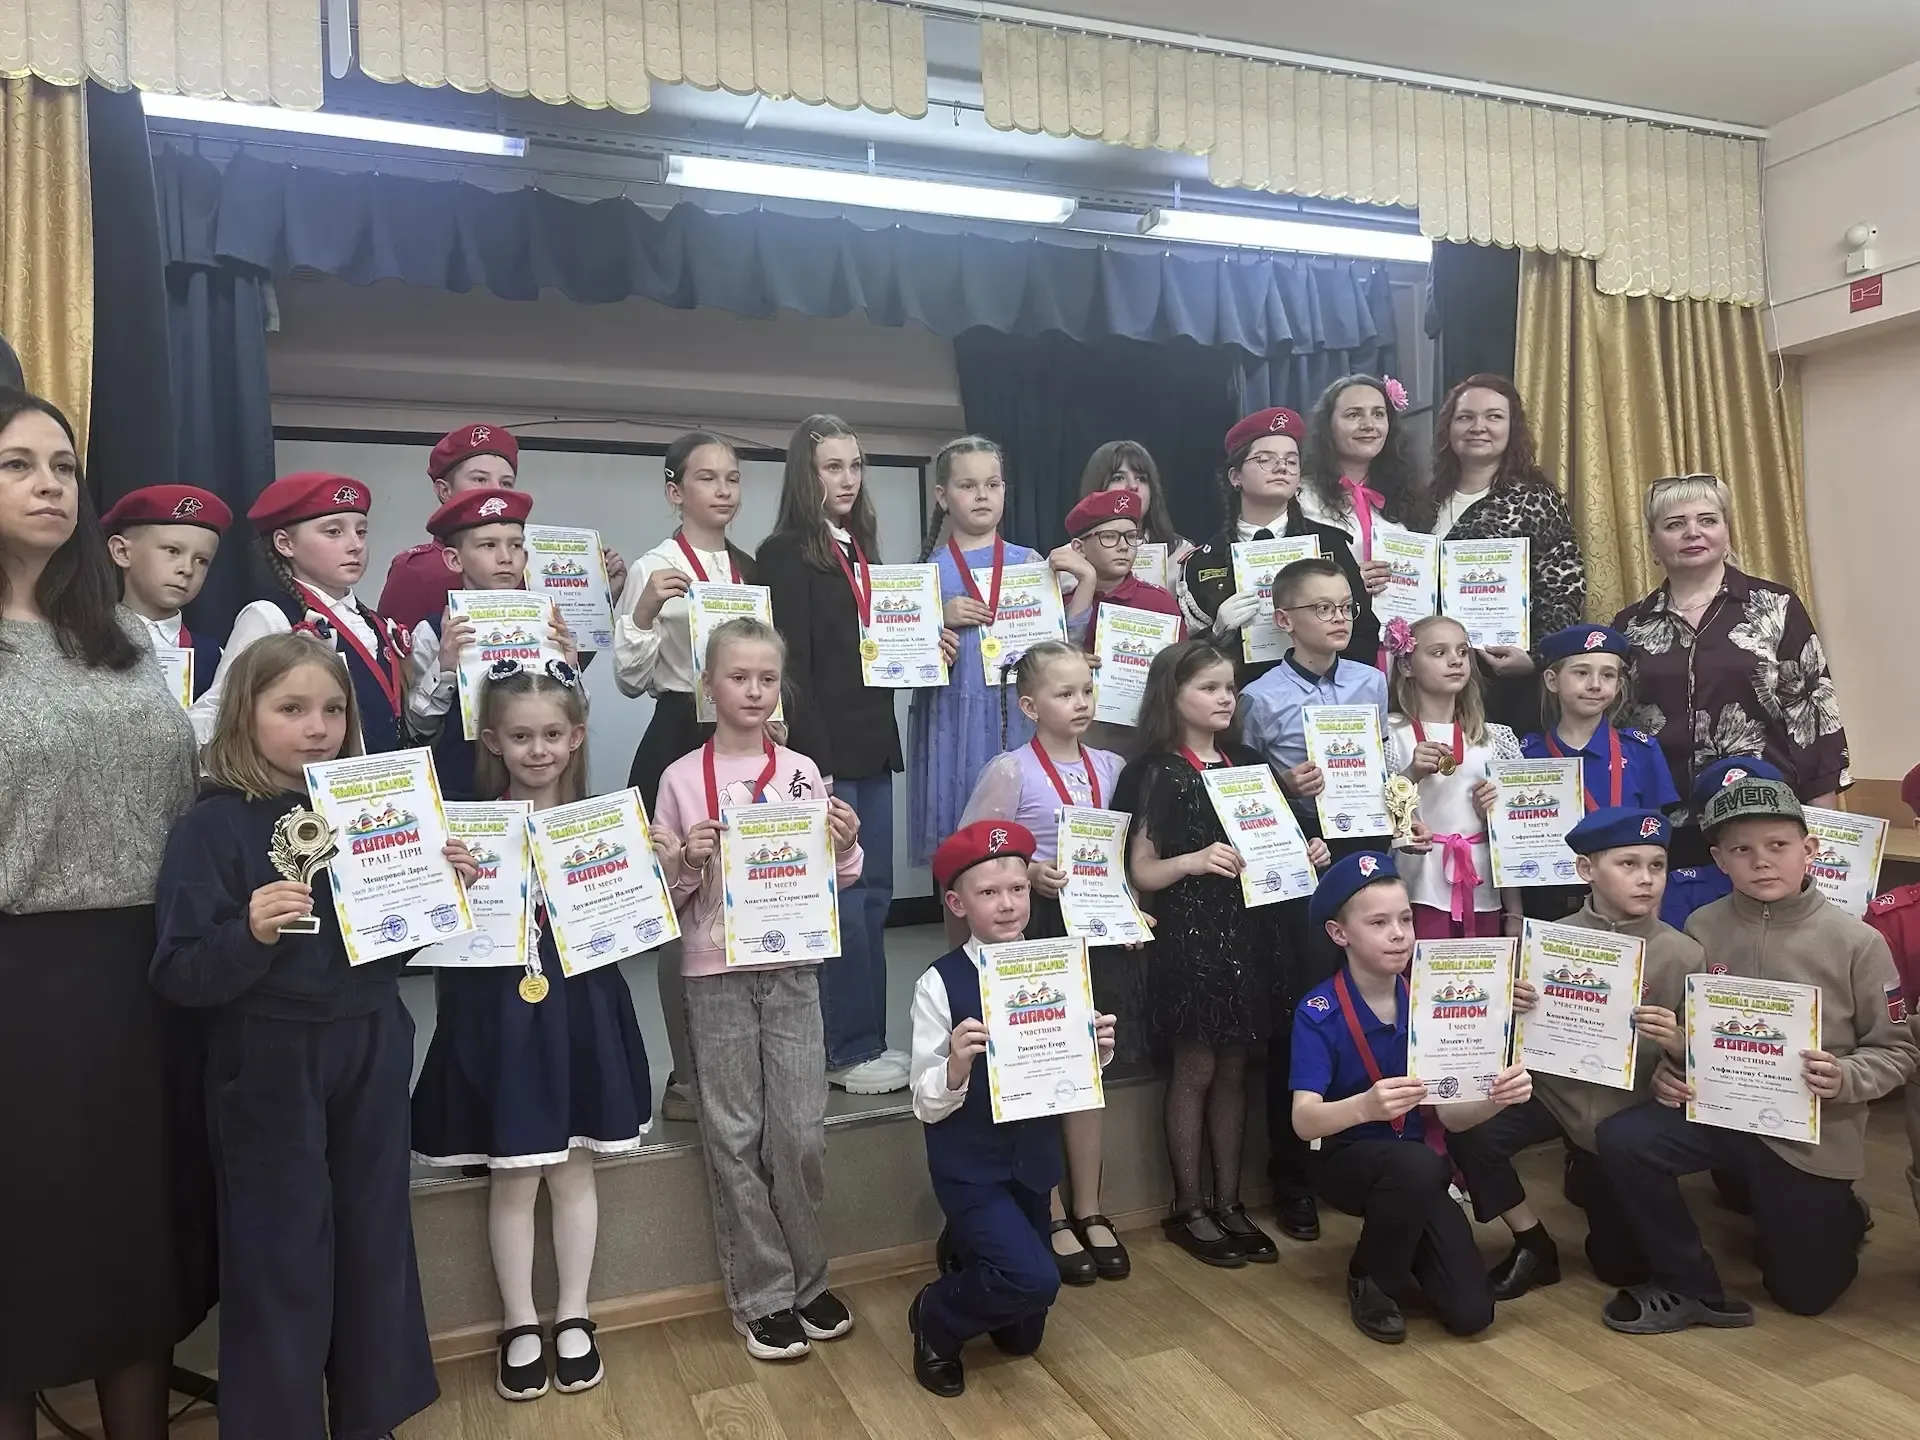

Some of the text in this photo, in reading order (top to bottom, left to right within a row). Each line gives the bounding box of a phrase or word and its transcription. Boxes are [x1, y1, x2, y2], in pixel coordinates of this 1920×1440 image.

[544, 578, 588, 588] ДИПЛОМ
[1460, 585, 1505, 594] ДИПЛОМ
[876, 614, 920, 623] ДИПЛОМ
[997, 608, 1041, 620] ДИПЛОМ
[481, 648, 540, 661] ДИПЛОМ
[1118, 667, 1148, 676] участник
[1328, 759, 1366, 768] ДИПЛОМ
[789, 769, 811, 798] 春
[1714, 786, 1778, 818] EVER
[1508, 808, 1558, 820] ДИПЛОМ
[1240, 816, 1278, 831] ДИПЛОМ
[352, 828, 420, 855] ДИПЛОМ
[361, 854, 391, 868] ГРАН
[400, 847, 423, 860] ПРИ
[407, 864, 429, 876] Дарье
[566, 856, 629, 885] ДИПЛОМ
[748, 863, 807, 880] ДИПЛОМ
[1073, 865, 1108, 877] ДИПЛОМ
[1805, 864, 1847, 882] ПЛОМ
[584, 876, 623, 893] III место
[615, 883, 644, 898] Валерии
[774, 880, 798, 889] место
[472, 897, 504, 906] Валерии
[778, 893, 820, 902] Старостиной
[1544, 984, 1608, 1005] ДИПЛОМ
[1432, 1005, 1488, 1019] ДИПЛОМ
[1553, 1000, 1600, 1014] участника
[1008, 1006, 1066, 1026] ДИПЛОМ
[1019, 1026, 1062, 1039] участника
[1048, 1040, 1067, 1050] Егору
[1713, 1037, 1784, 1057] ДИПЛОМ
[1724, 1054, 1777, 1067] участника
[1757, 1071, 1792, 1082] Савелию
